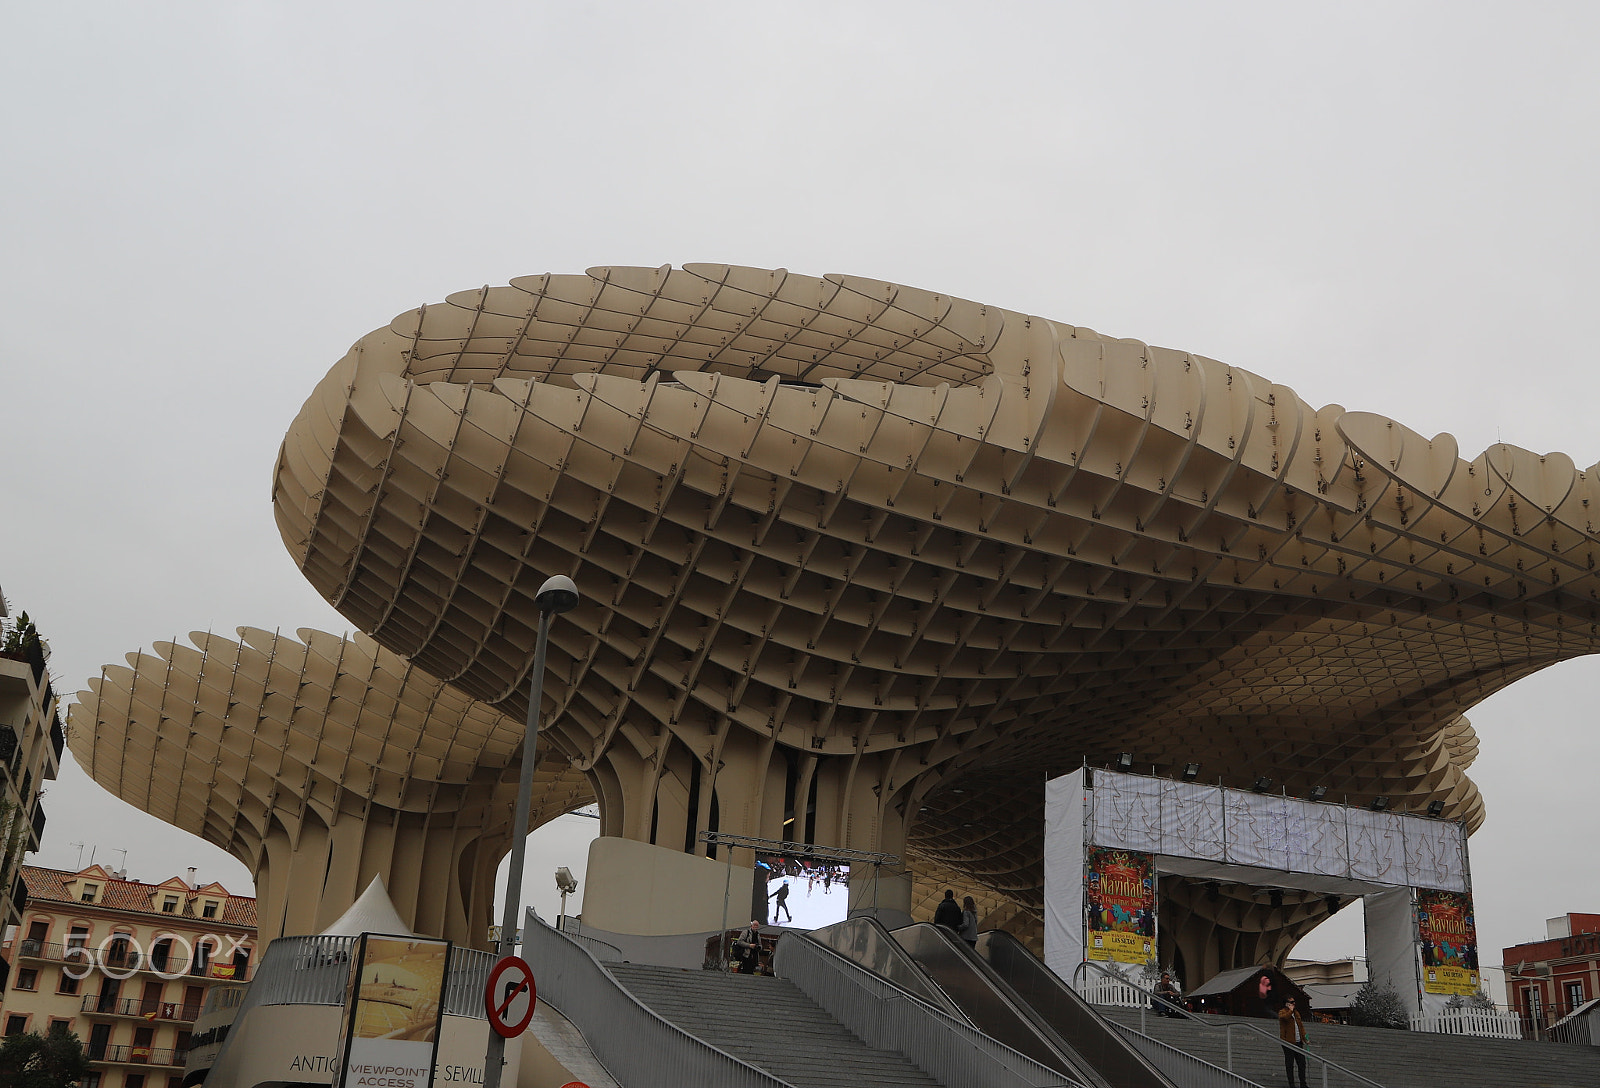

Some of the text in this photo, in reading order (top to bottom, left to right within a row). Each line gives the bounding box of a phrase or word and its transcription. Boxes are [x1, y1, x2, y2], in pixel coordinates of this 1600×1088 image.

[1100, 873, 1143, 899] Navidad
[1429, 913, 1466, 935] Navidad
[1561, 936, 1600, 956] HOT
[350, 1064, 429, 1078] VIEWPOINT
[443, 1064, 483, 1084] SEVILL
[357, 1076, 415, 1088] ACCESS
